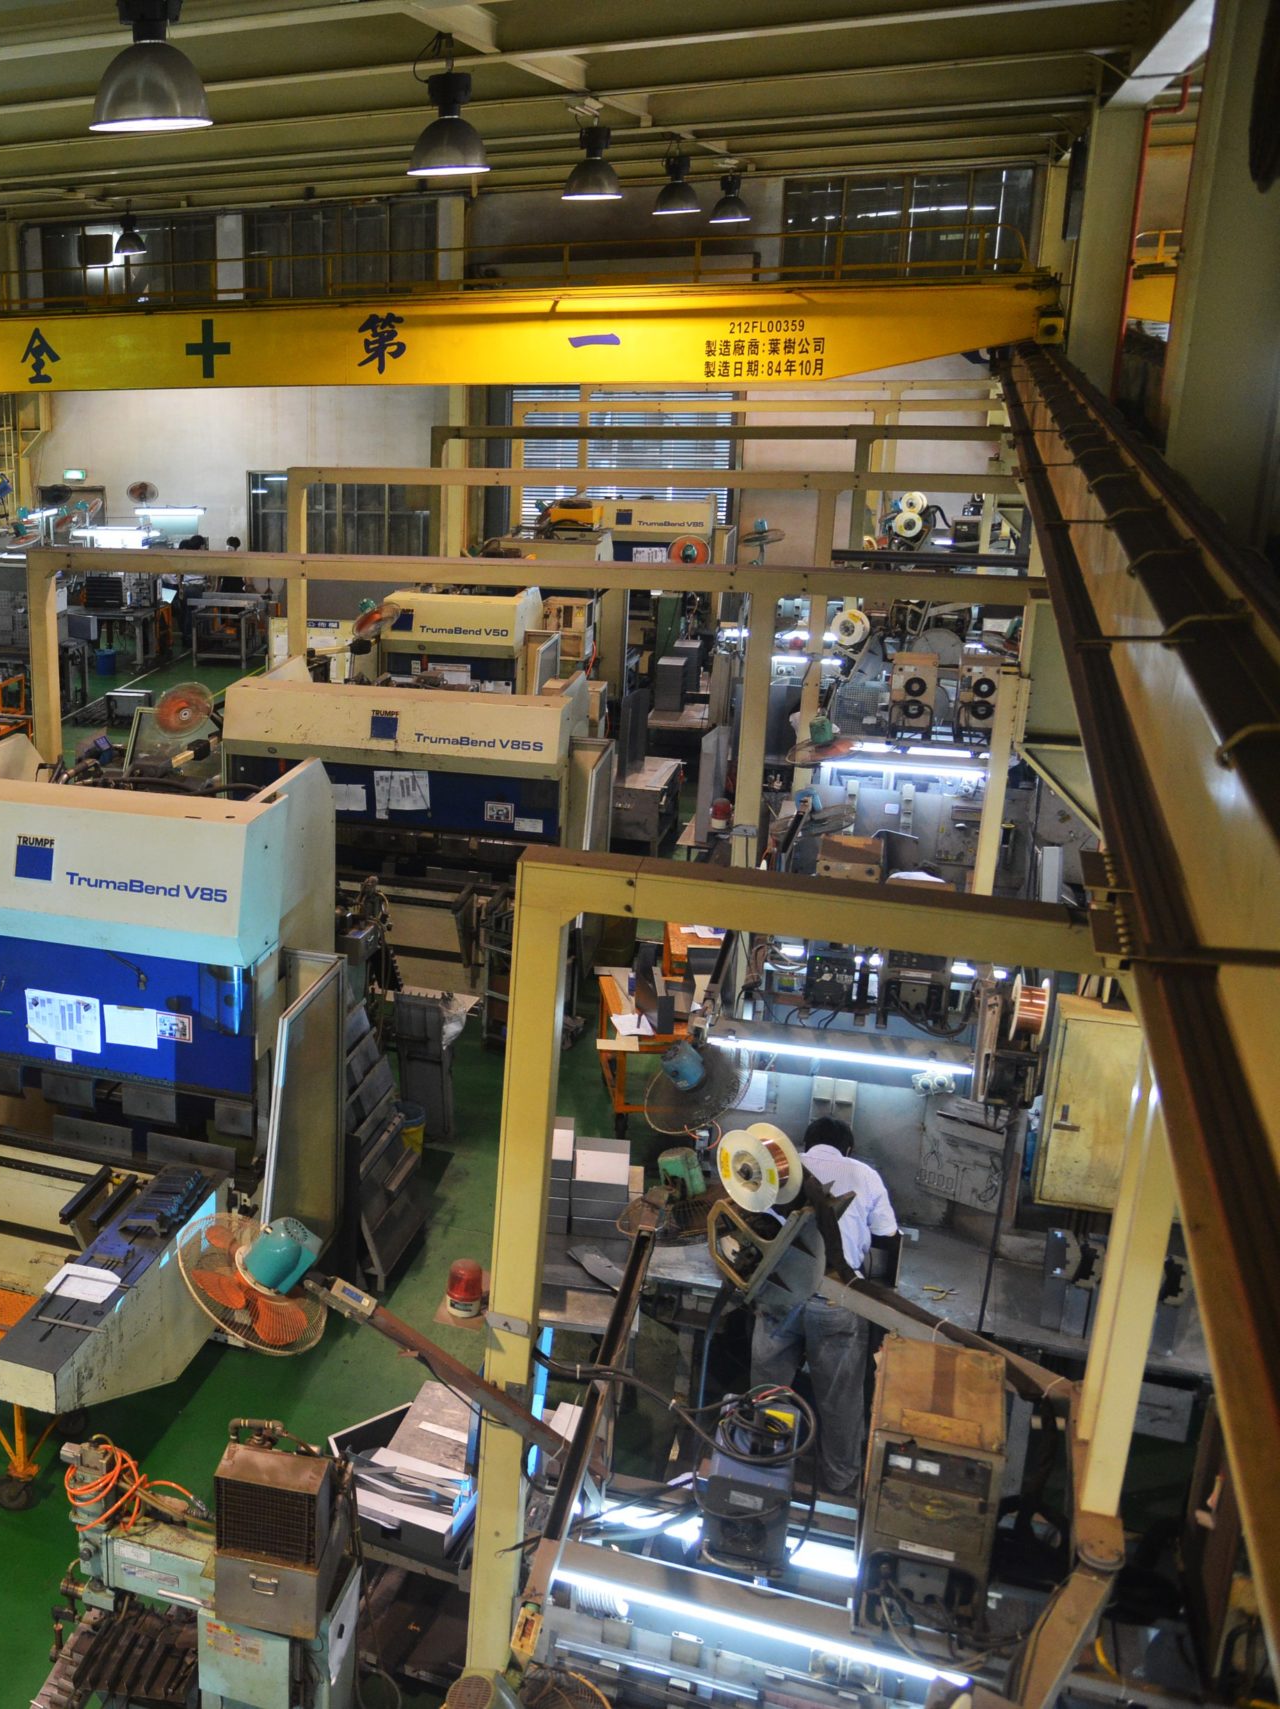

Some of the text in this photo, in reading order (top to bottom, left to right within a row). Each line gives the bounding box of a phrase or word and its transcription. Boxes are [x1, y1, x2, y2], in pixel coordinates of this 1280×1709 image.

[729, 320, 805, 334] 212FL00359
[20, 327, 61, 384] 全
[357, 312, 407, 375] 第
[568, 333, 621, 348] 一
[419, 625, 509, 638] TrumaBend V50
[371, 709, 400, 717] TRUMPF
[414, 732, 544, 752] TrumaBend V85S
[17, 835, 55, 848] TRUMPF
[66, 871, 228, 903] TrumaBend V85
